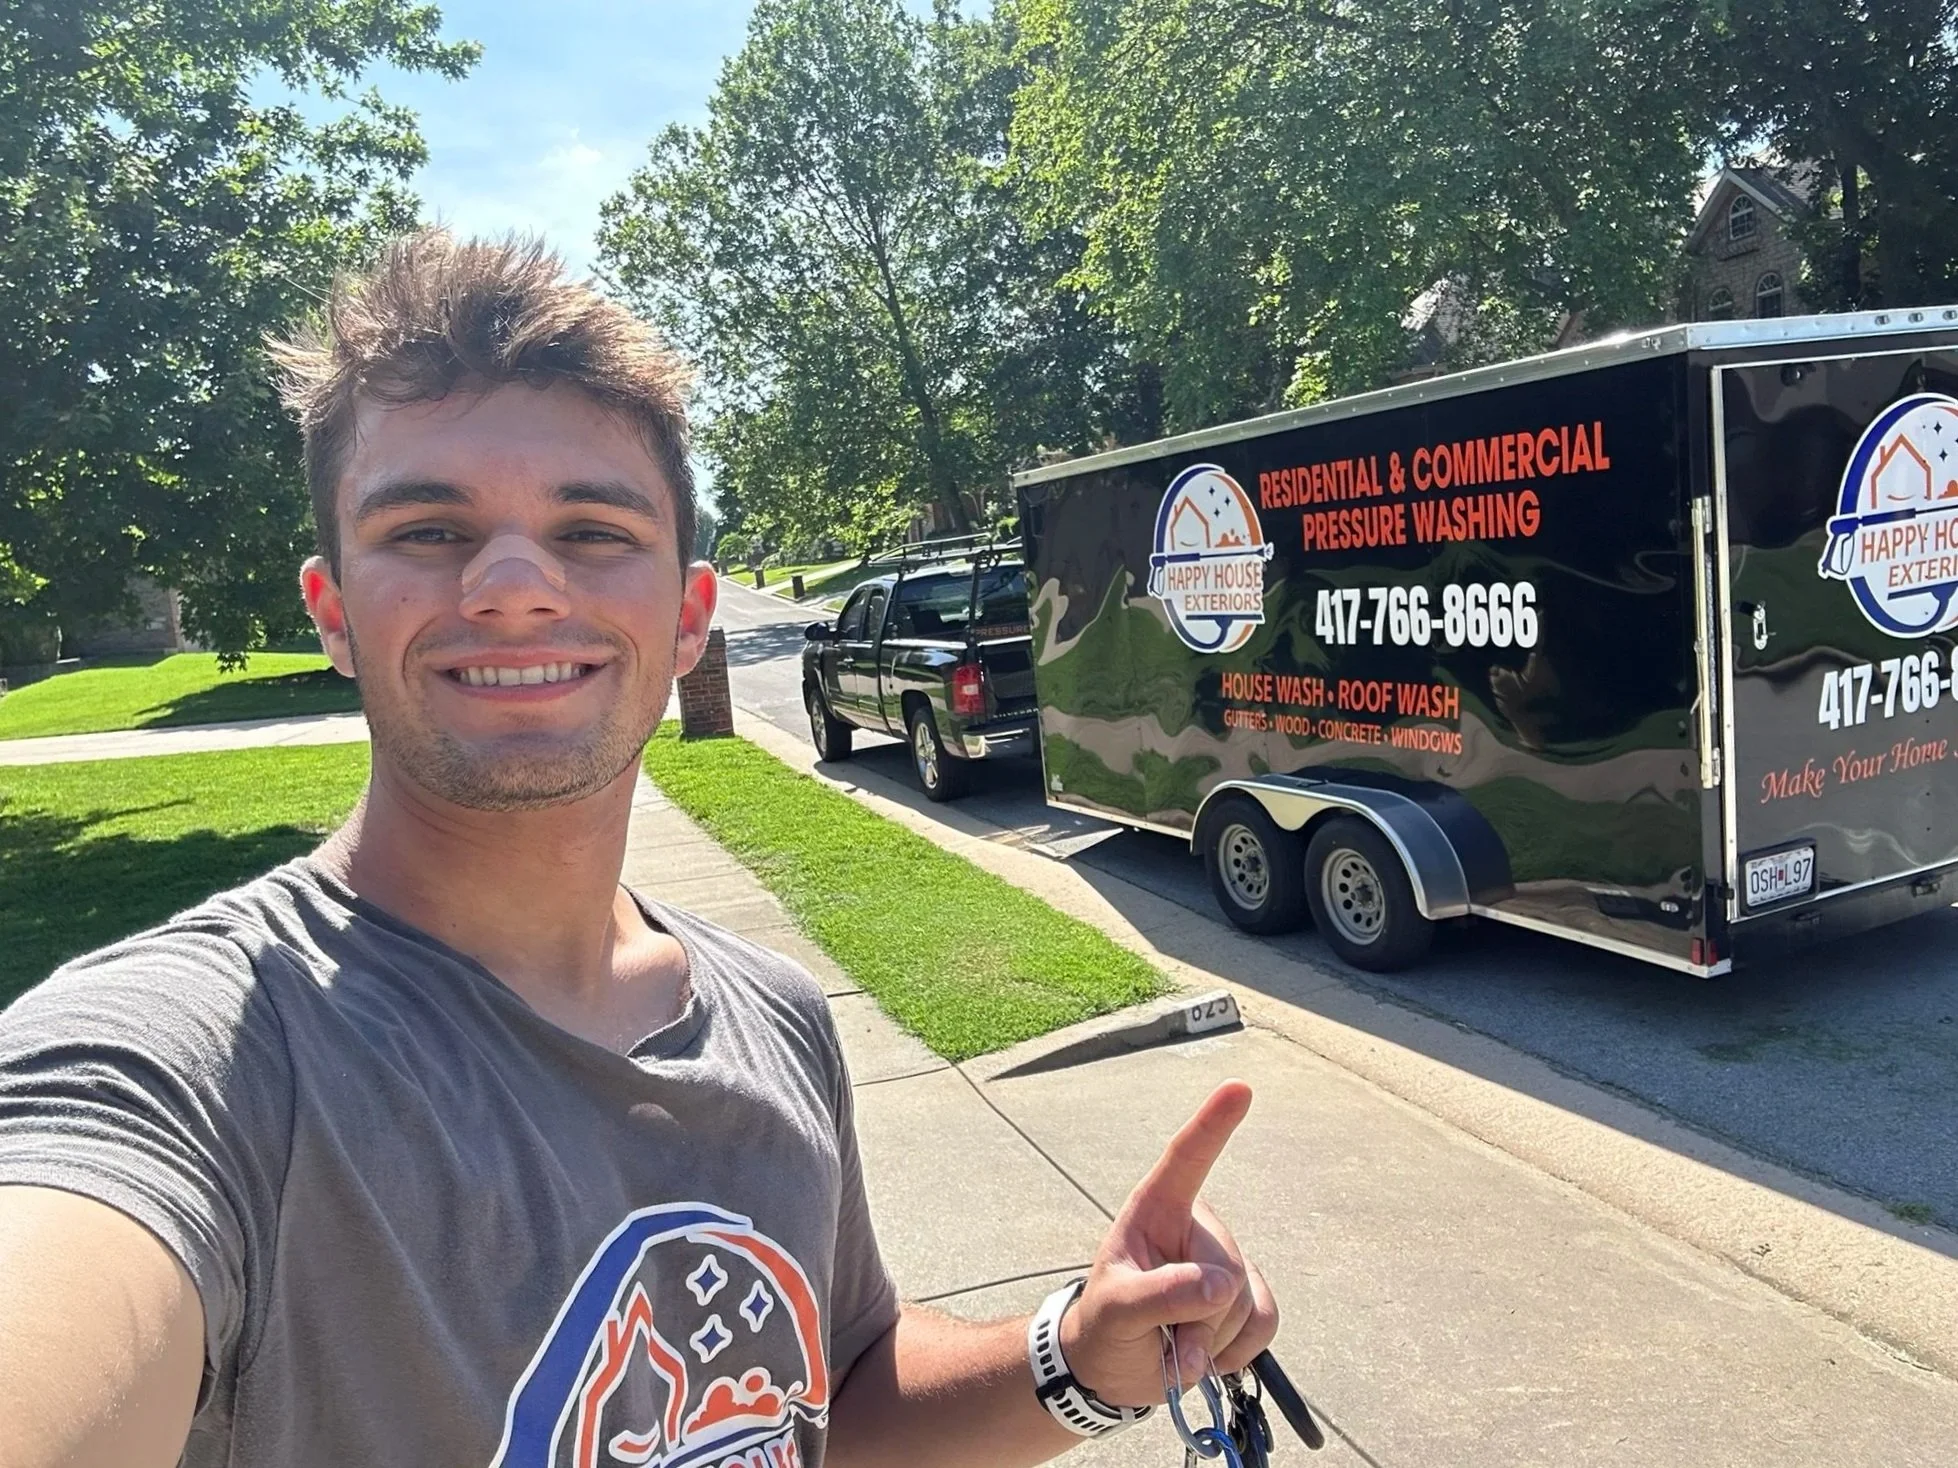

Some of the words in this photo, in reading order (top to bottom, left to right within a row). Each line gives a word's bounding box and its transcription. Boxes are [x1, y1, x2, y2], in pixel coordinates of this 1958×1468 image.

[1259, 455, 1384, 510] RESIDENTIAL
[1389, 451, 1407, 495] &
[1412, 421, 1610, 491] COMMERCIAL
[1303, 503, 1407, 551] PRESSURE
[1411, 489, 1540, 543] WASHING
[1861, 522, 1930, 564] HAPPY
[1167, 564, 1211, 591] HAPPY
[1214, 561, 1262, 589] HOUSE
[1184, 592, 1262, 611] EXTERIORS
[1315, 581, 1538, 648] 417-766-8666
[1222, 672, 1273, 703] HOUSE
[1276, 675, 1325, 707] WASH
[1338, 679, 1393, 713] ROOF
[1397, 682, 1459, 719] WASH
[1224, 709, 1268, 731] GUTTERS
[1275, 714, 1311, 736] WOOD
[1318, 719, 1382, 745] CONCRETE
[1391, 726, 1463, 755] WINDOWS
[1761, 758, 1826, 804] Make
[1832, 749, 1887, 784] Your
[1889, 737, 1948, 773] Home
